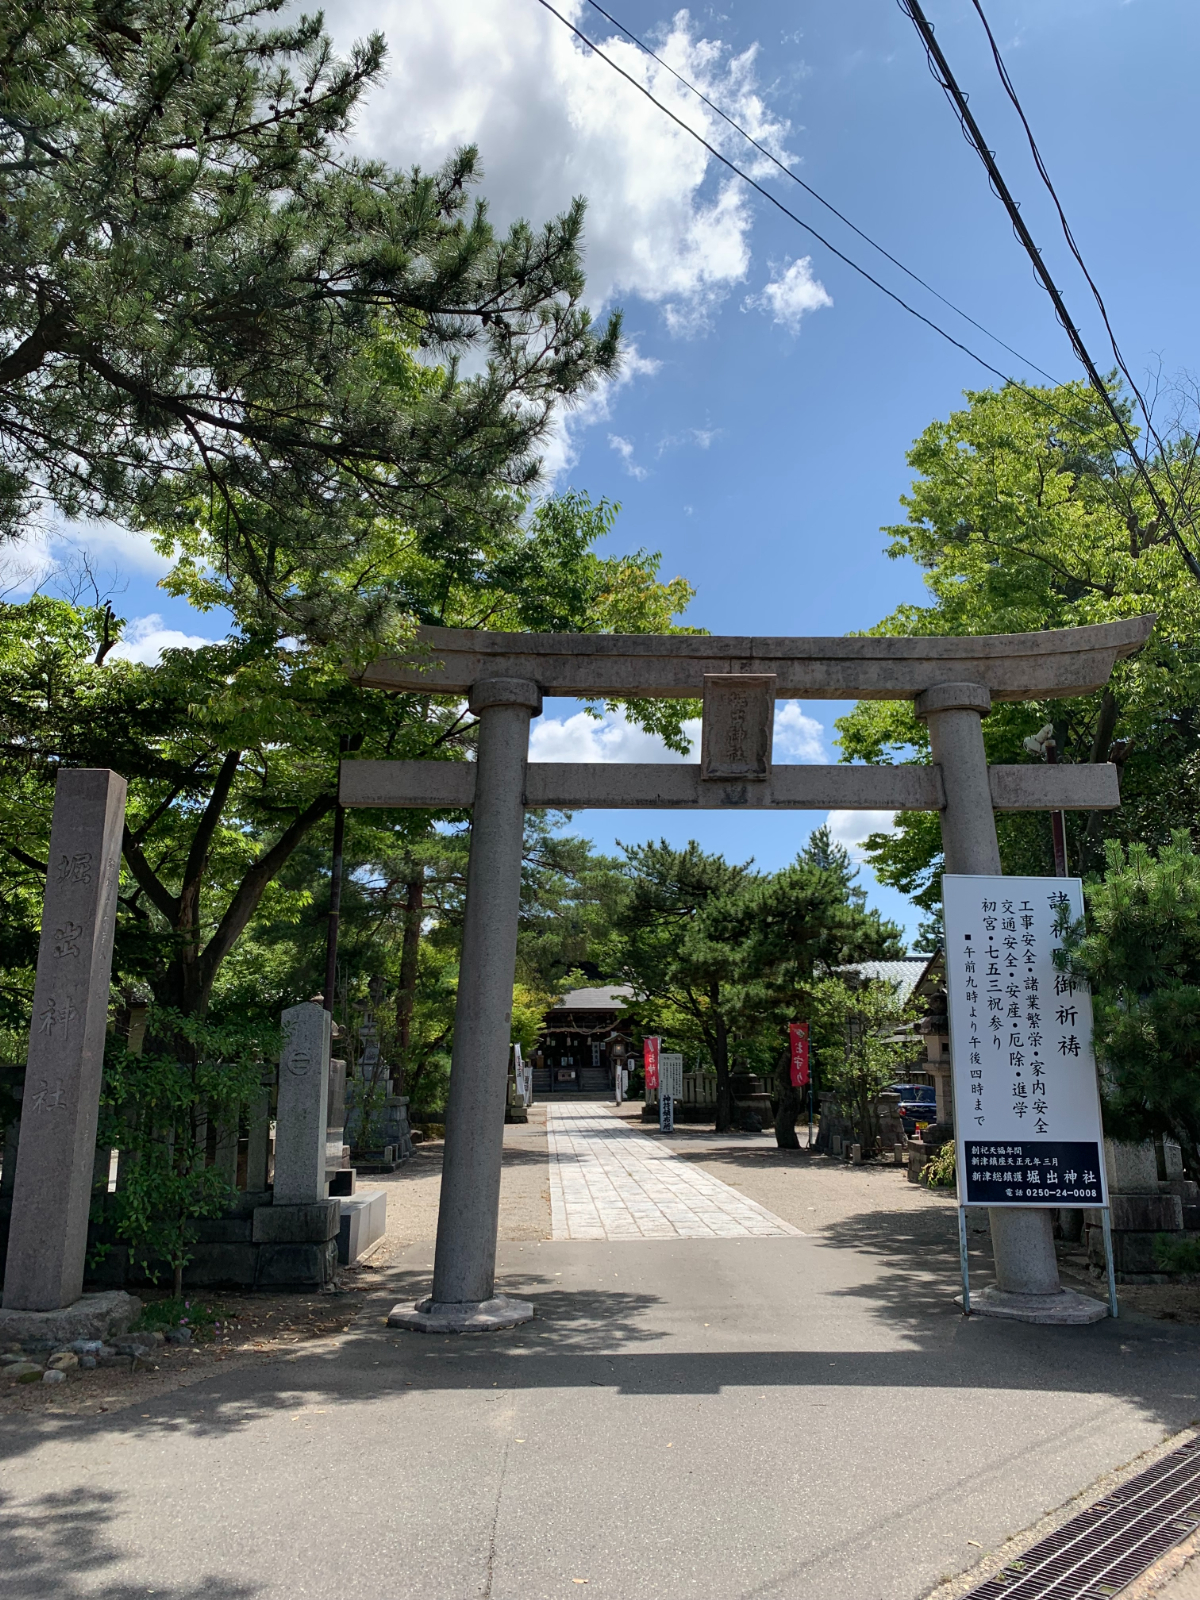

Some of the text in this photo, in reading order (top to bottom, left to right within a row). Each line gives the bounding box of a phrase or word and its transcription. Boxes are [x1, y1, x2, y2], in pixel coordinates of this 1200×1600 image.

[31, 851, 93, 1114] 堀出神社
[963, 945, 986, 1127] 午前九時より午後四時まで
[981, 898, 1005, 1051] 初宮・七五三祝参り
[1001, 899, 1029, 1119] 交通安全・安産・厄除・進学
[1018, 901, 1050, 1134] 工事安全・諸業繁栄・家内安全
[971, 1156, 1059, 1167] 新津鎮座天正元年三月
[972, 1169, 1097, 1185] 新津総鎮護 堀出神社
[1005, 1188, 1097, 1197] 電話 0250-24-0008
